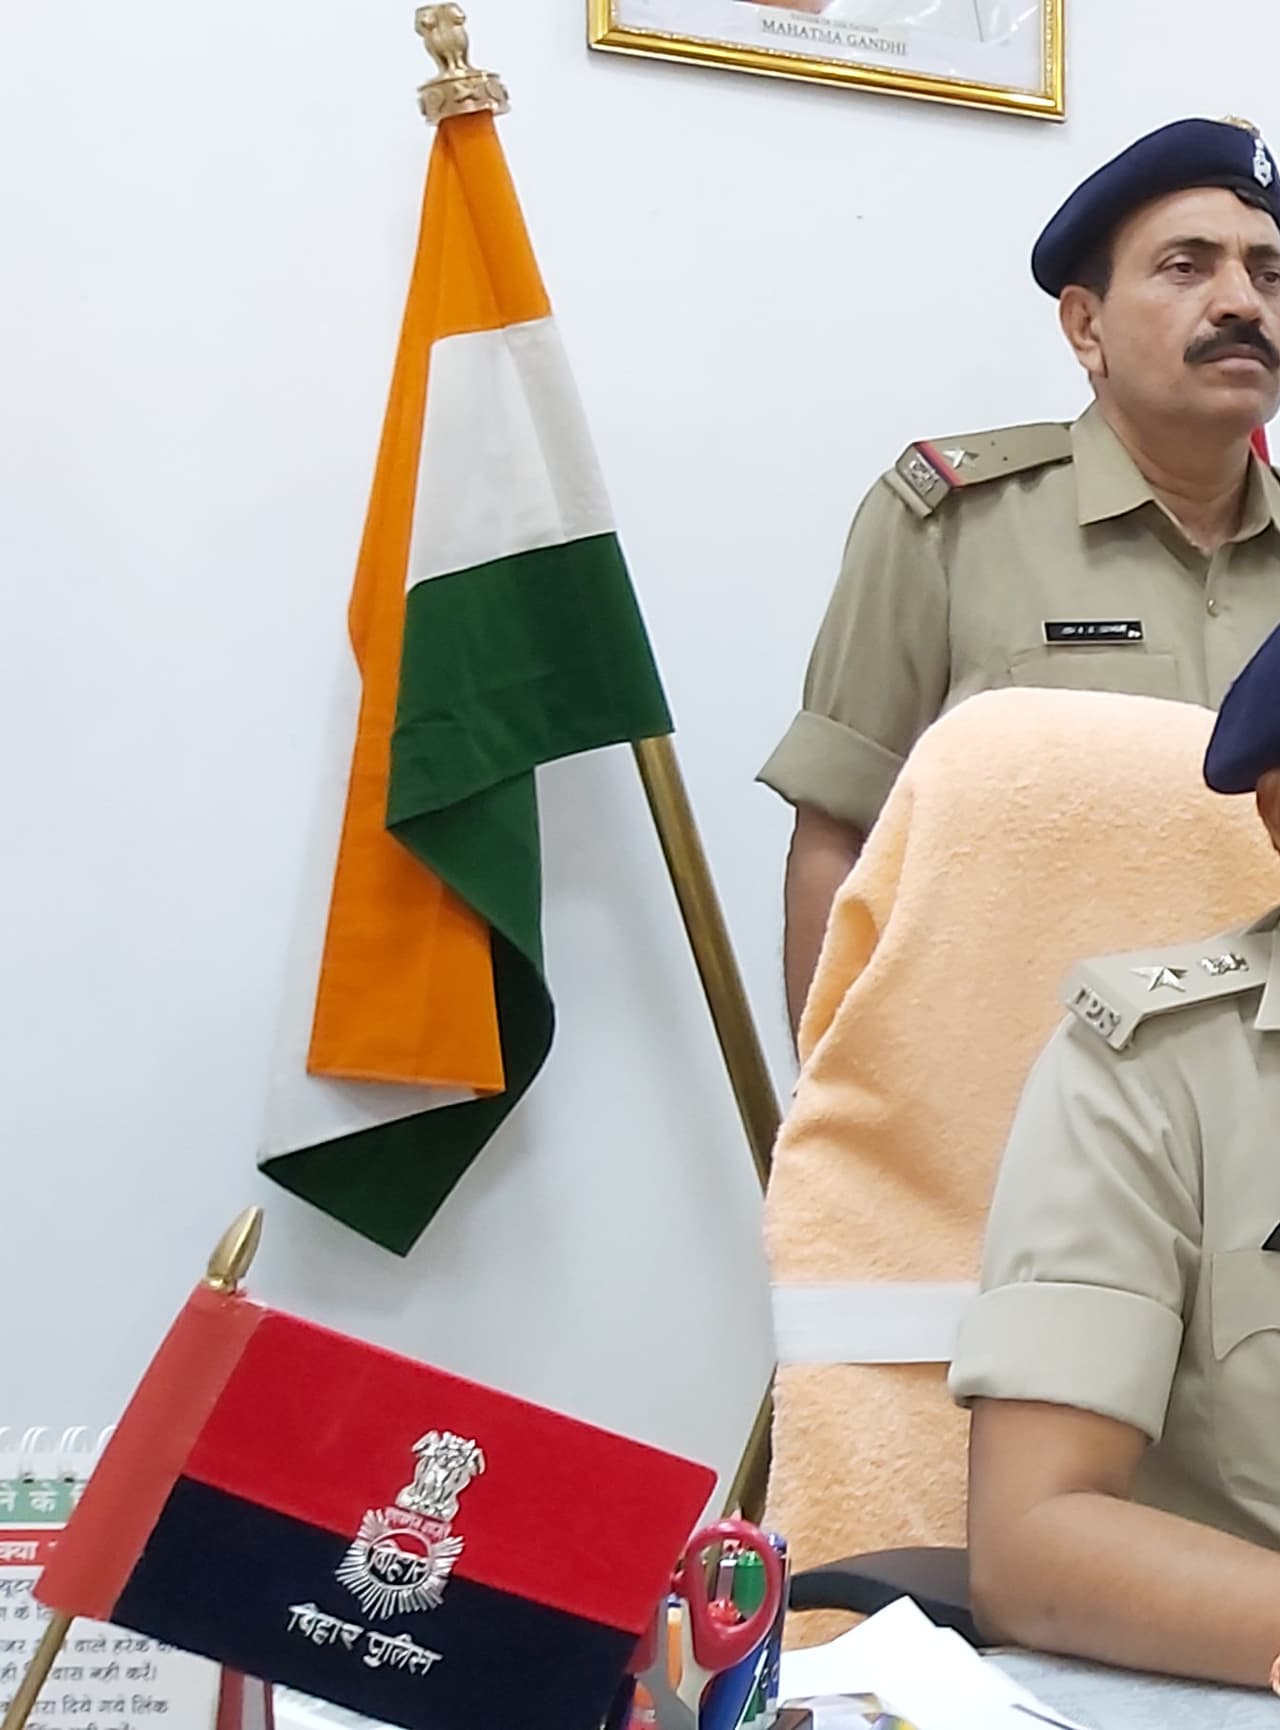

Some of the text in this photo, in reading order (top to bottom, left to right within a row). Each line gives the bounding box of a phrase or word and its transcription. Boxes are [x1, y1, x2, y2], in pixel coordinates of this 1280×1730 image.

[762, 19, 842, 44] MAHATMA
[847, 34, 906, 56] GANDHI
[287, 1602, 444, 1676] बिहार पुलिस
